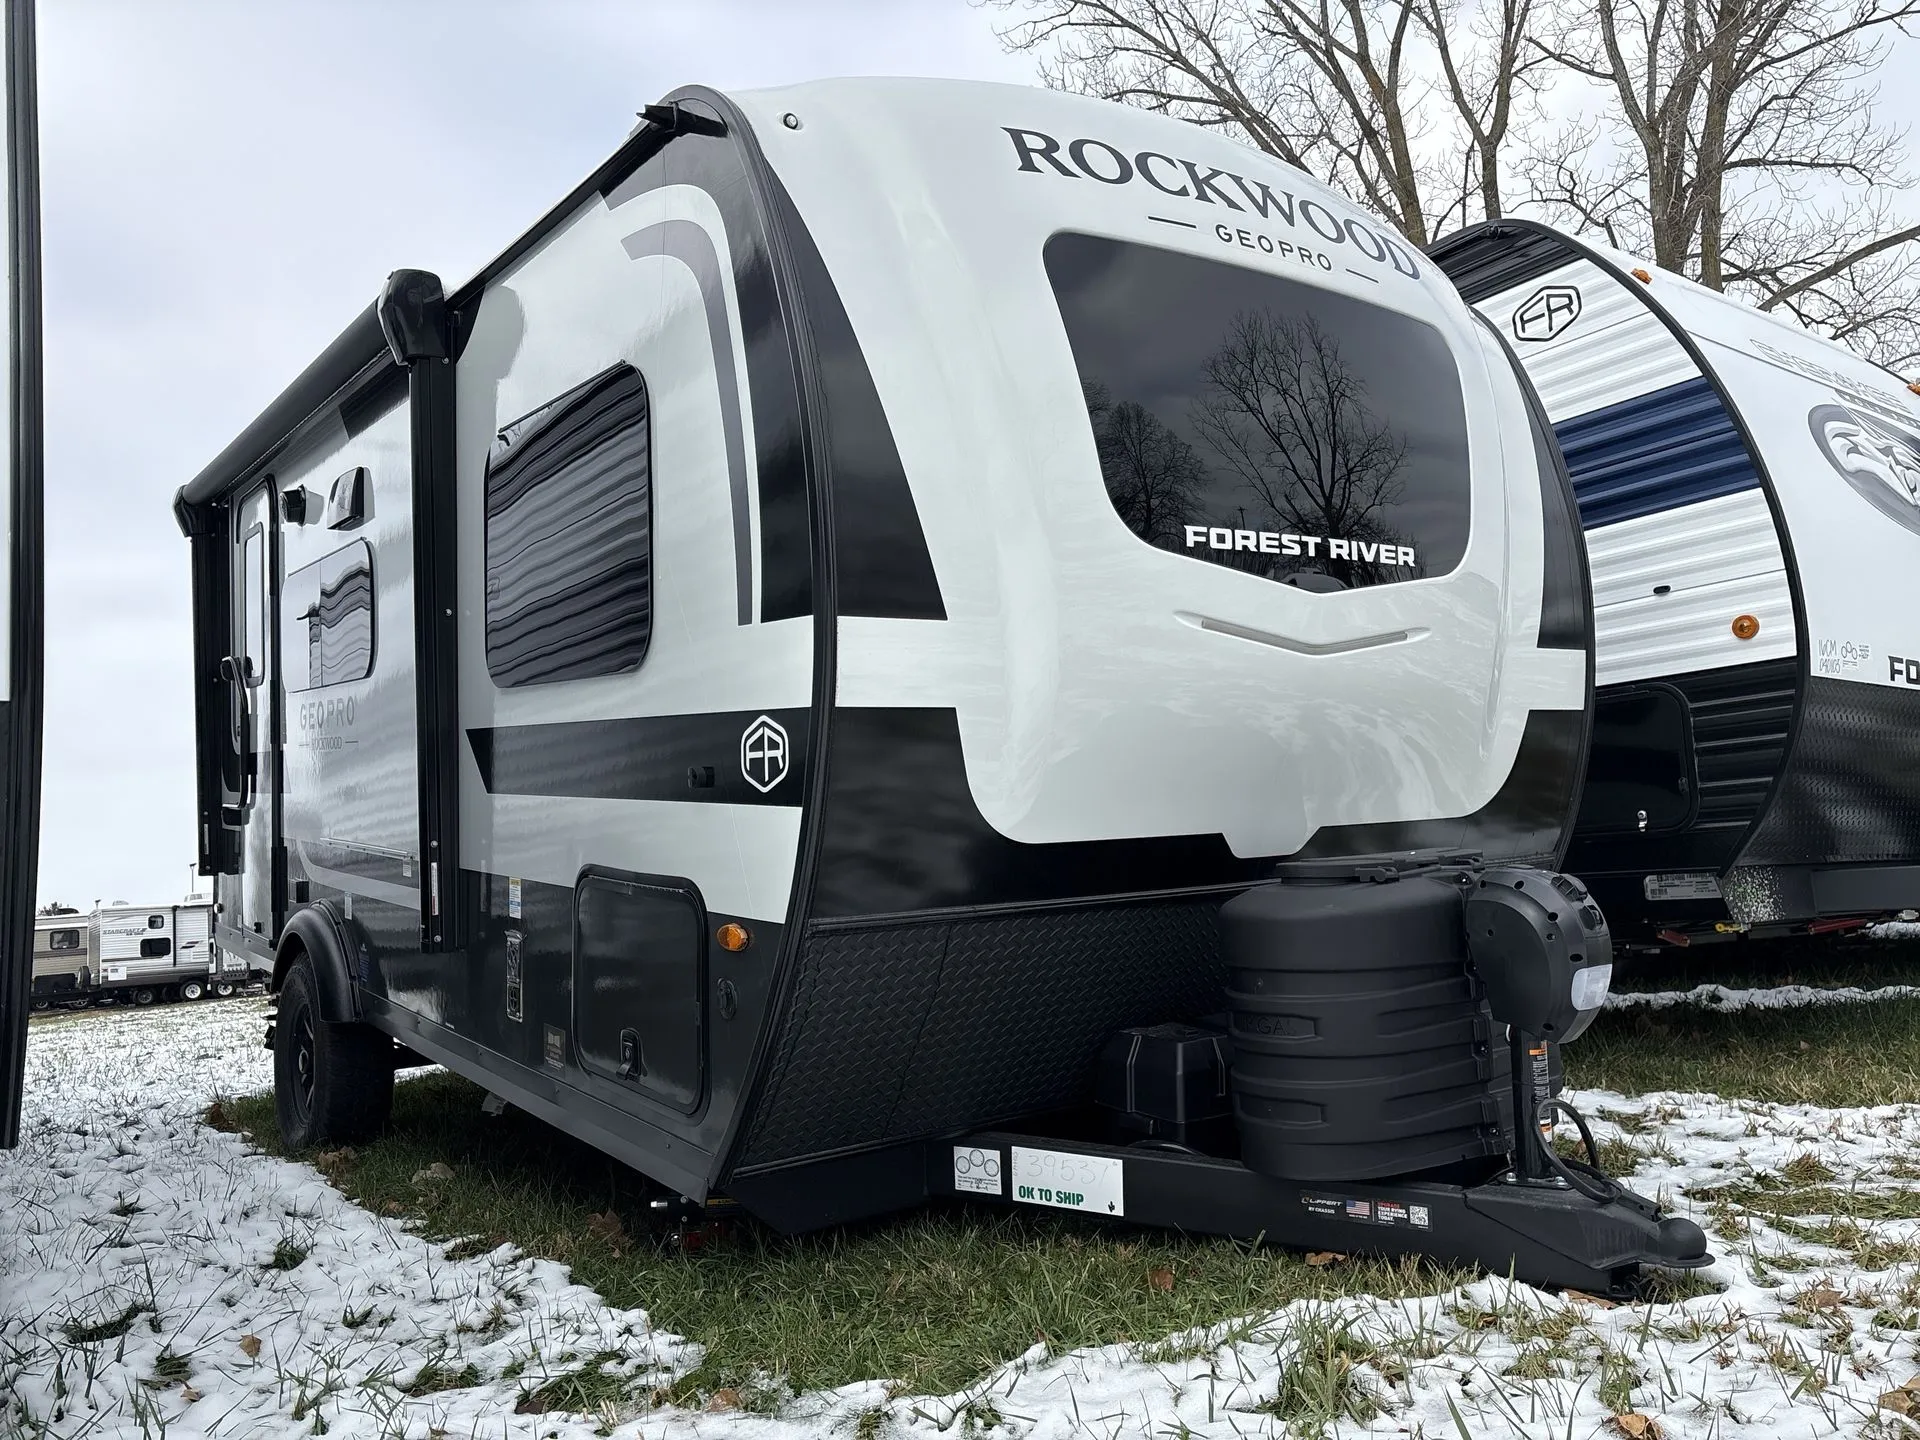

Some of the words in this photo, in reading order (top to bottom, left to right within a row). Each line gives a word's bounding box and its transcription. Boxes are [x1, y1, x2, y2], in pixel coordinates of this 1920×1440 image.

[1000, 126, 1422, 281] ROCKWOOD
[1214, 223, 1332, 272] GEOPRO
[1183, 524, 1321, 557] FOREST
[1328, 536, 1416, 567] RIVER
[299, 695, 355, 730] GEOPRO
[1026, 1154, 1109, 1189] 39537
[1018, 1185, 1035, 1200] OK
[1037, 1188, 1053, 1203] TO
[1055, 1190, 1084, 1206] SHIP
[1378, 1211, 1408, 1219] EXPERIENCE
